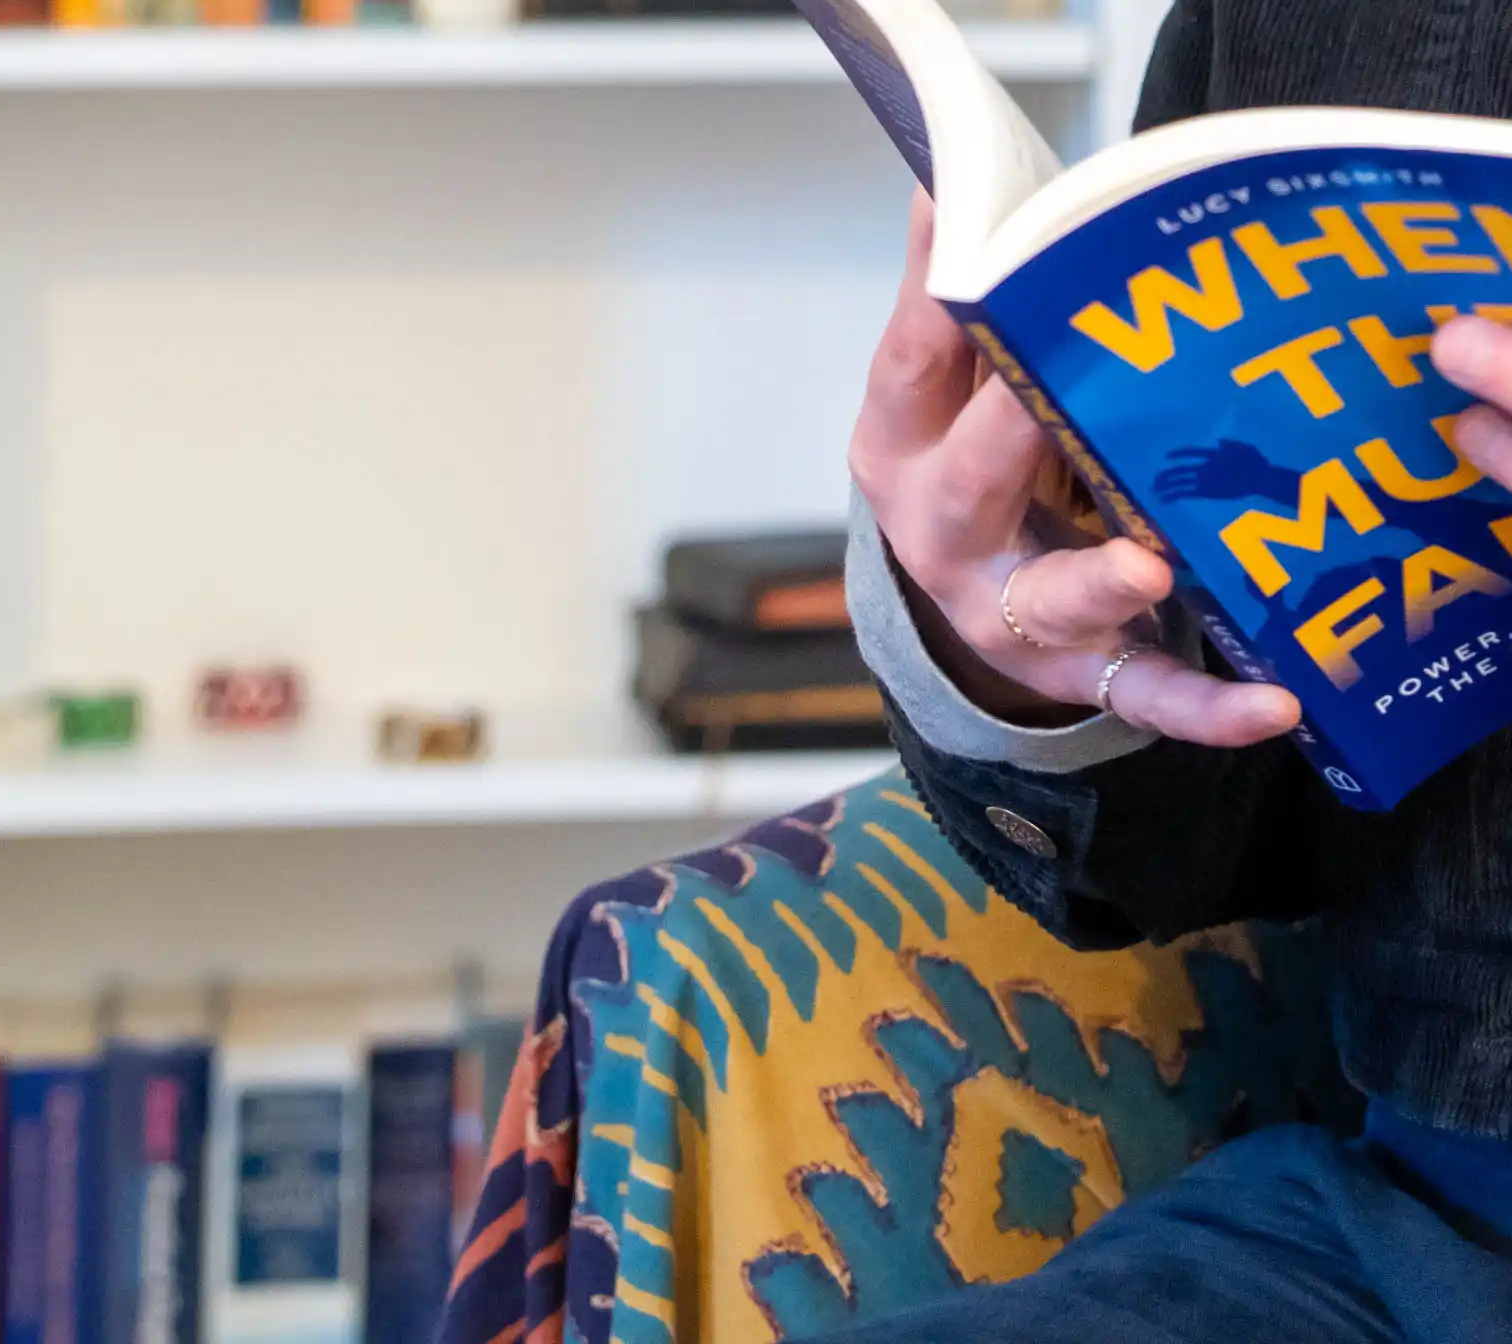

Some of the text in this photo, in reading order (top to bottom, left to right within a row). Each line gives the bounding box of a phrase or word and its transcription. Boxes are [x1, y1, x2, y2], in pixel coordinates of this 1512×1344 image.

[1156, 185, 1251, 236] LUCY
[1219, 413, 1488, 599] MU
[1425, 657, 1498, 705] THE
